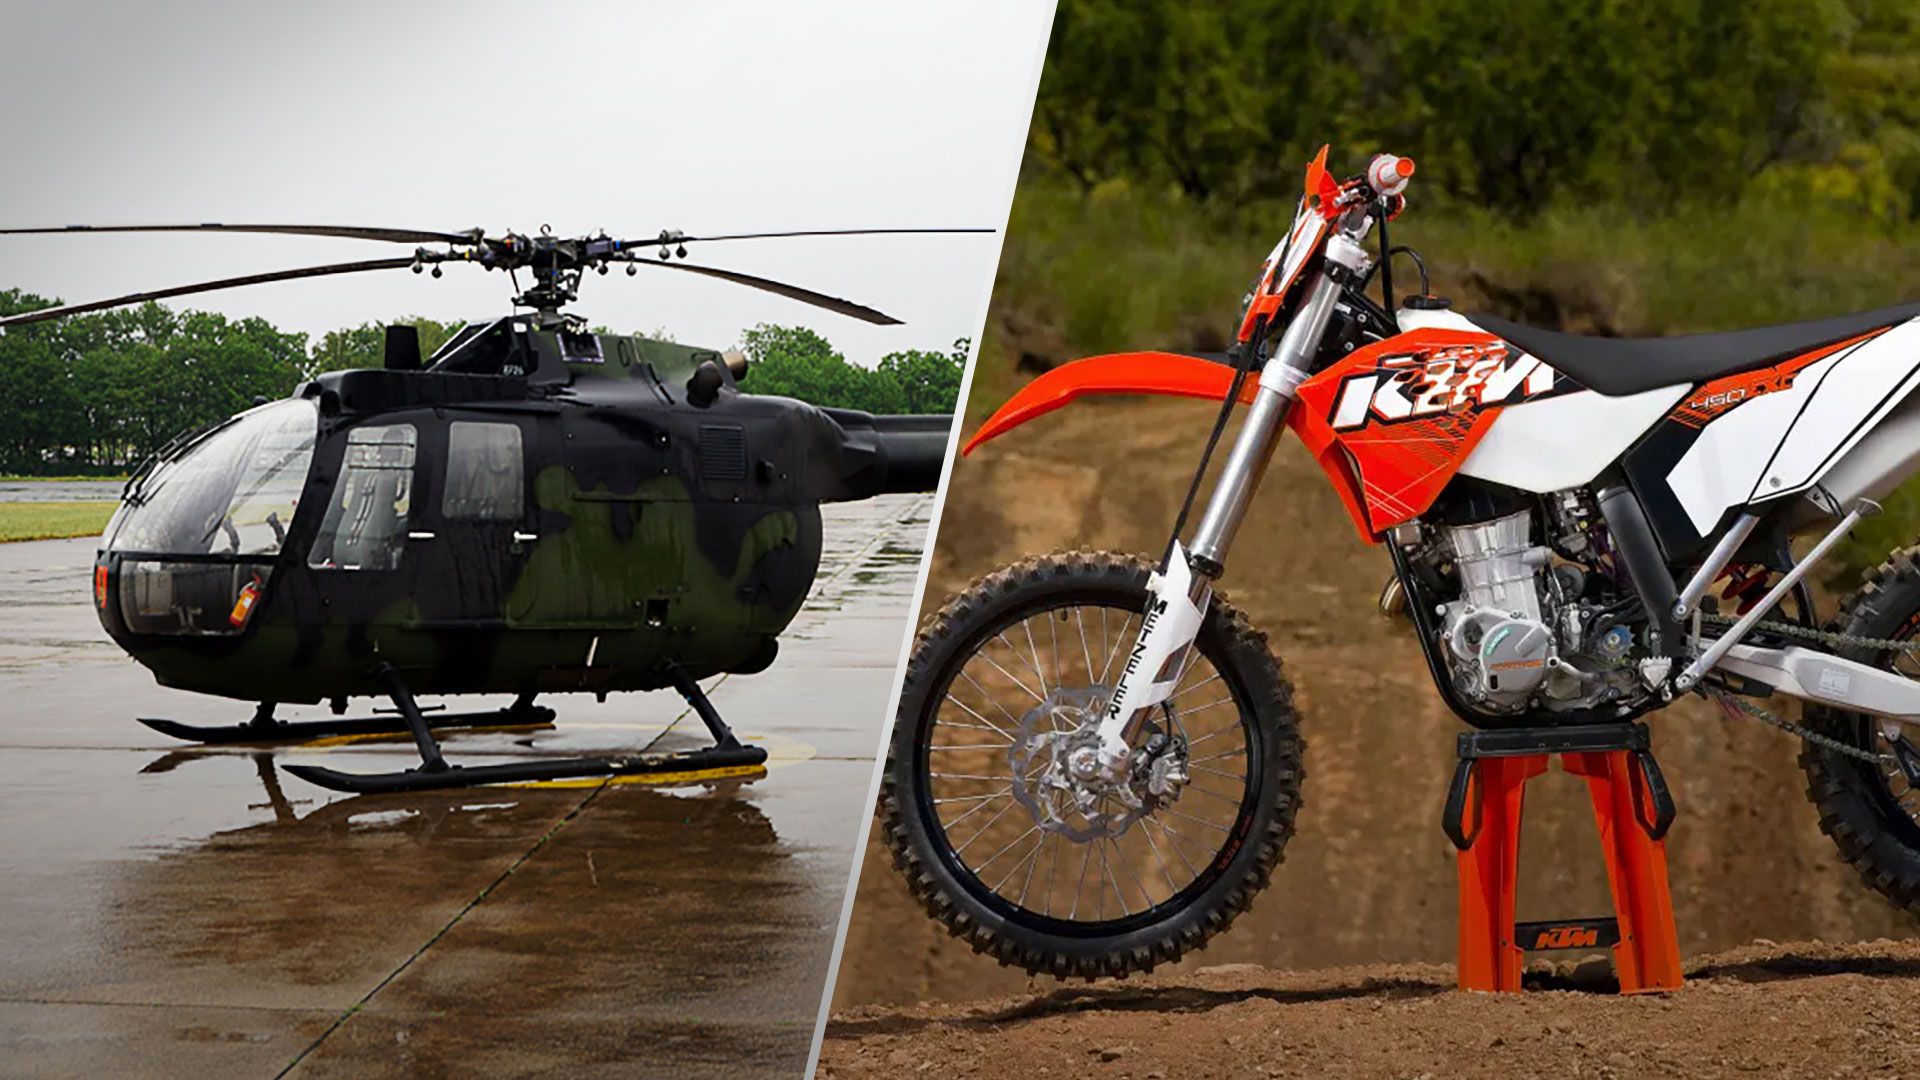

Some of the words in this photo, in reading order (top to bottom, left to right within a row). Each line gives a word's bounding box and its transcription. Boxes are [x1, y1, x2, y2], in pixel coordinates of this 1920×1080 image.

[1331, 340, 1556, 430] KTM
[1691, 388, 1747, 409] 450
[1106, 590, 1168, 720] METZELER
[1535, 926, 1599, 949] KTM
